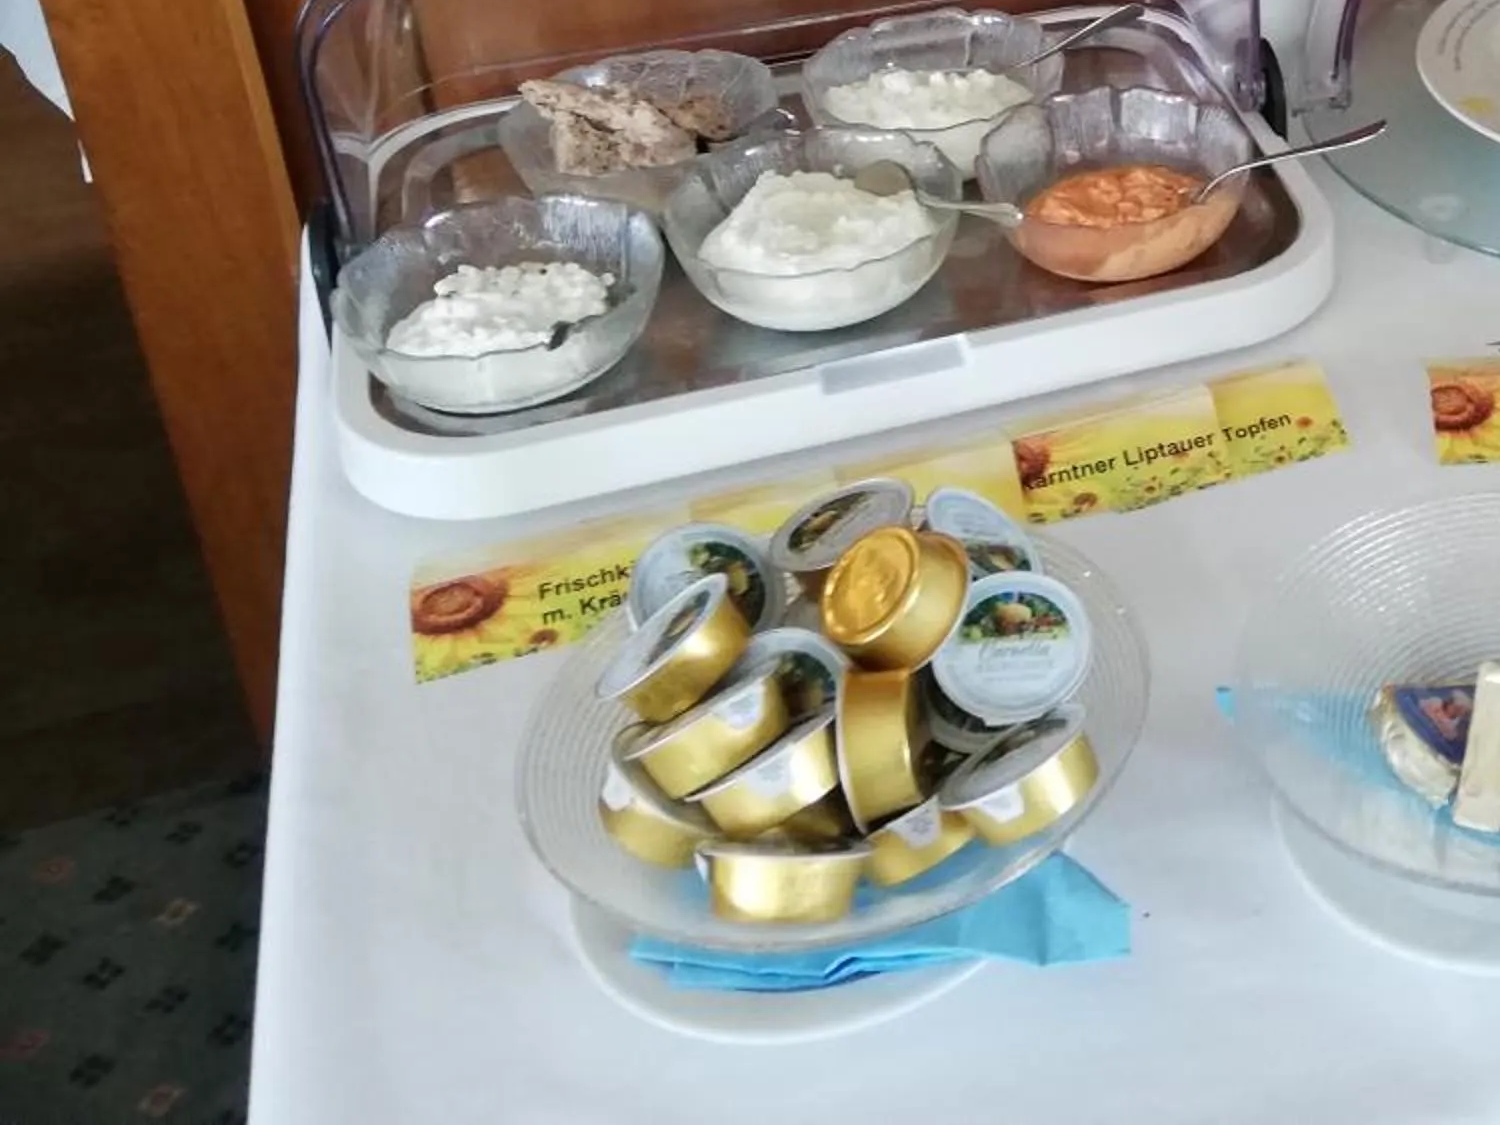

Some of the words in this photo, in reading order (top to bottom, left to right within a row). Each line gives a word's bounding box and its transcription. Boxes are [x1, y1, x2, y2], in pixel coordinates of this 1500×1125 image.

[1222, 412, 1293, 443] Topfen
[1123, 432, 1214, 468] Liptauer
[539, 559, 637, 601] Frischk
[543, 607, 573, 625] m.
